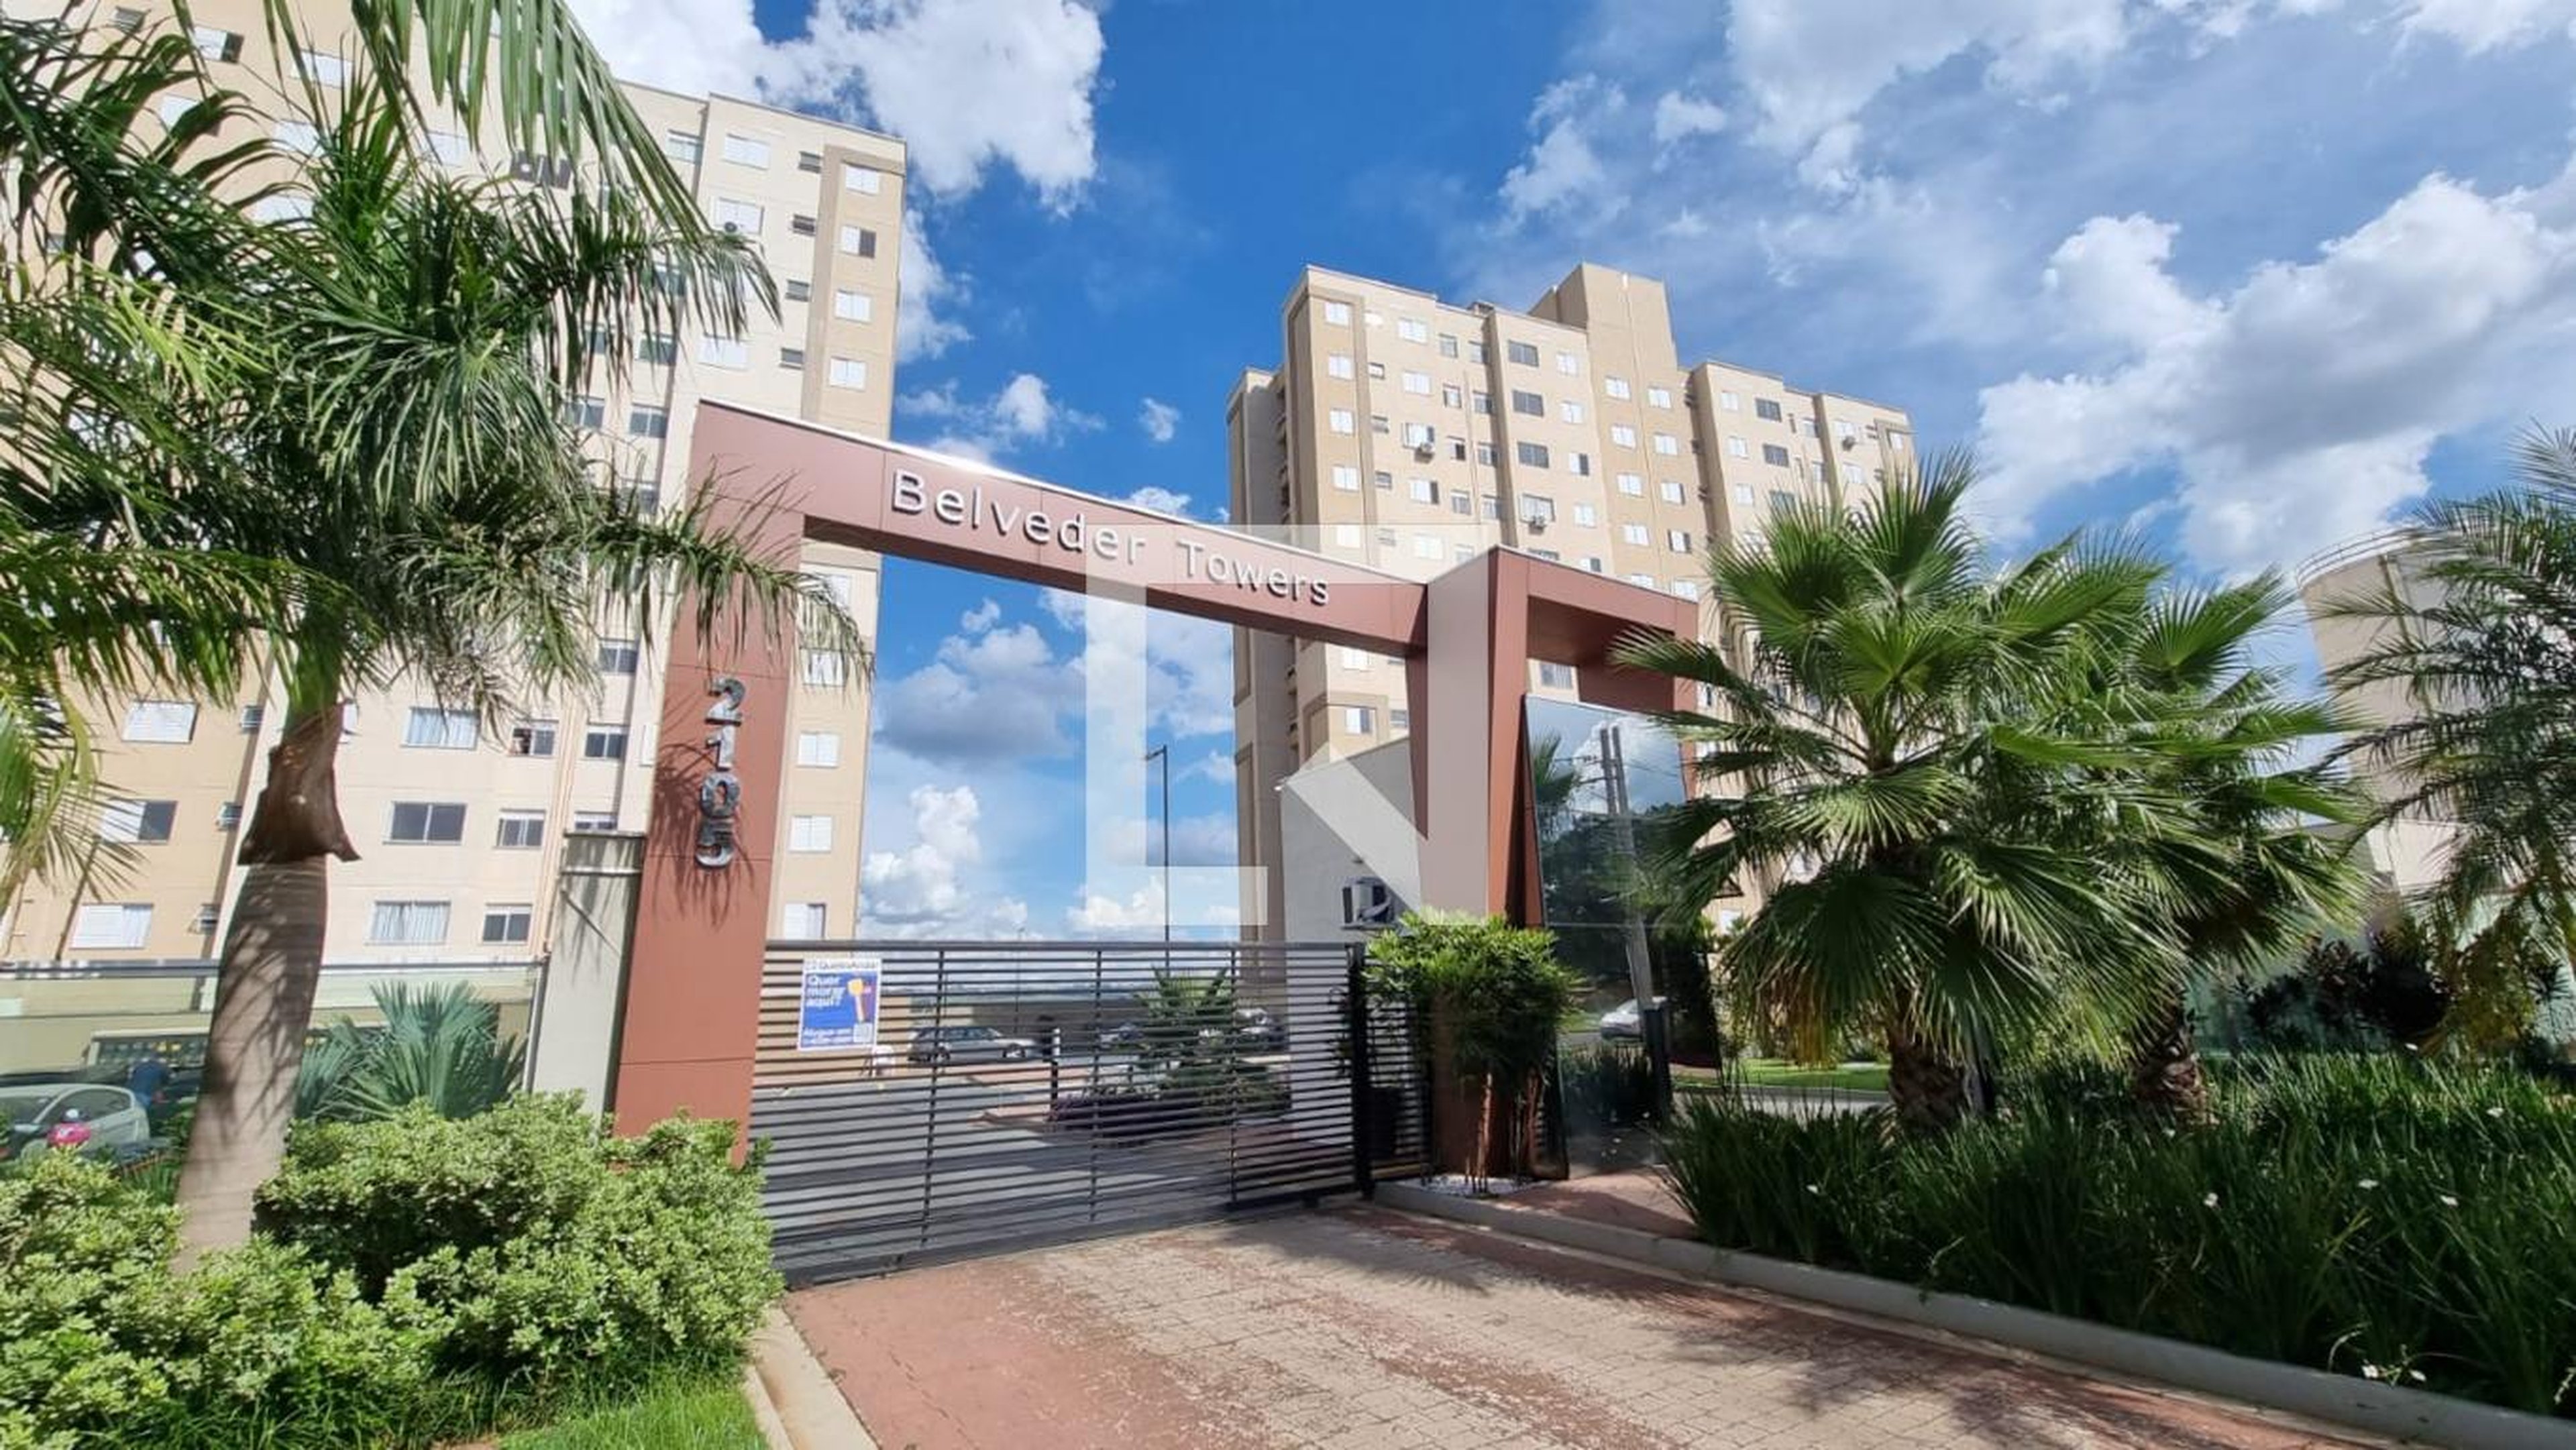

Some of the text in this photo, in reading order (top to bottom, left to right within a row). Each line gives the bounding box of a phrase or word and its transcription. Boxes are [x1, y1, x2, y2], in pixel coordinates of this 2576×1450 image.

[891, 468, 1330, 605] Belveder Towers
[808, 974, 840, 986] Quer
